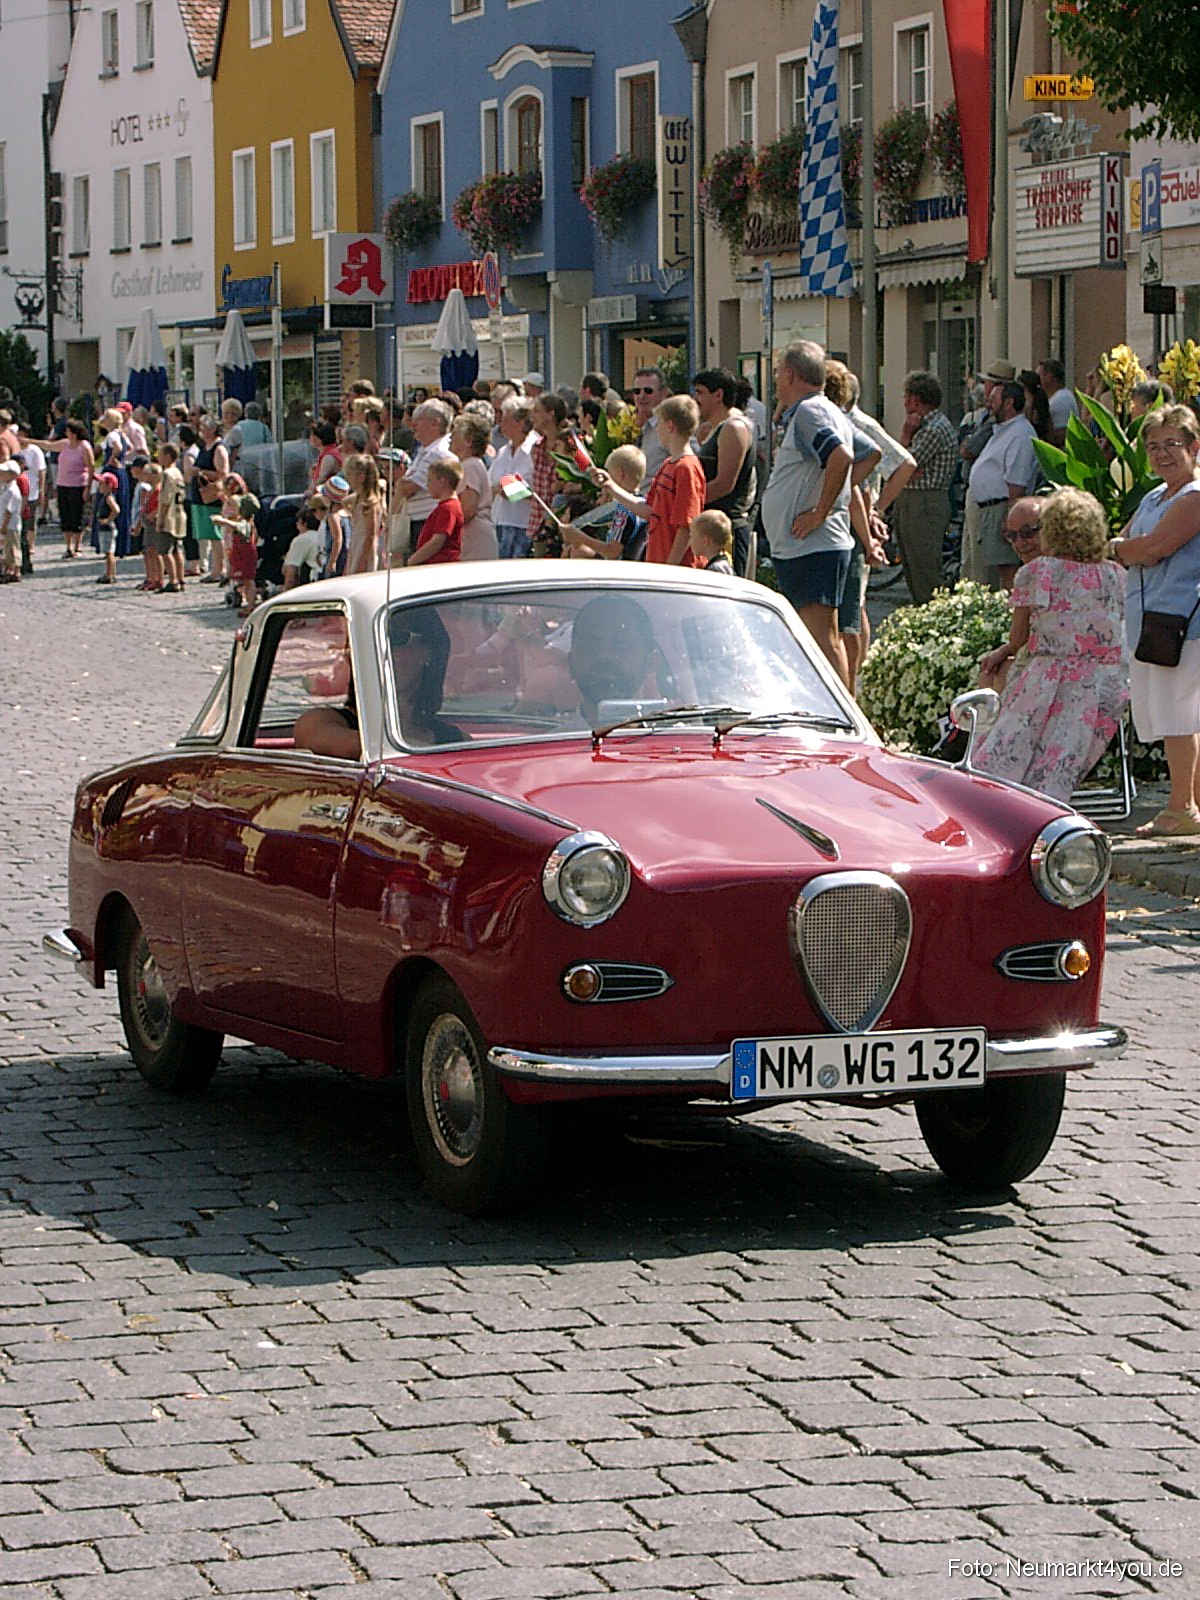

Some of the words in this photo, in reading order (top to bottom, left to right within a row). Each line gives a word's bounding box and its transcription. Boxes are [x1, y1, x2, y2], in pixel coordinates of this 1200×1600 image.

[1035, 80, 1067, 97] KINO
[110, 115, 143, 146] HOTEL
[665, 145, 687, 255] WITTL
[1026, 179, 1092, 208] TRAUMSCHIFF
[1035, 203, 1083, 229] SURPRISE
[1106, 160, 1119, 259] KINO
[112, 266, 154, 298] Gasthof
[406, 260, 505, 304] APOTHEK
[759, 1045, 813, 1090] NM
[844, 1042, 895, 1085] WG
[907, 1038, 980, 1082] 132
[739, 1075, 750, 1089] D
